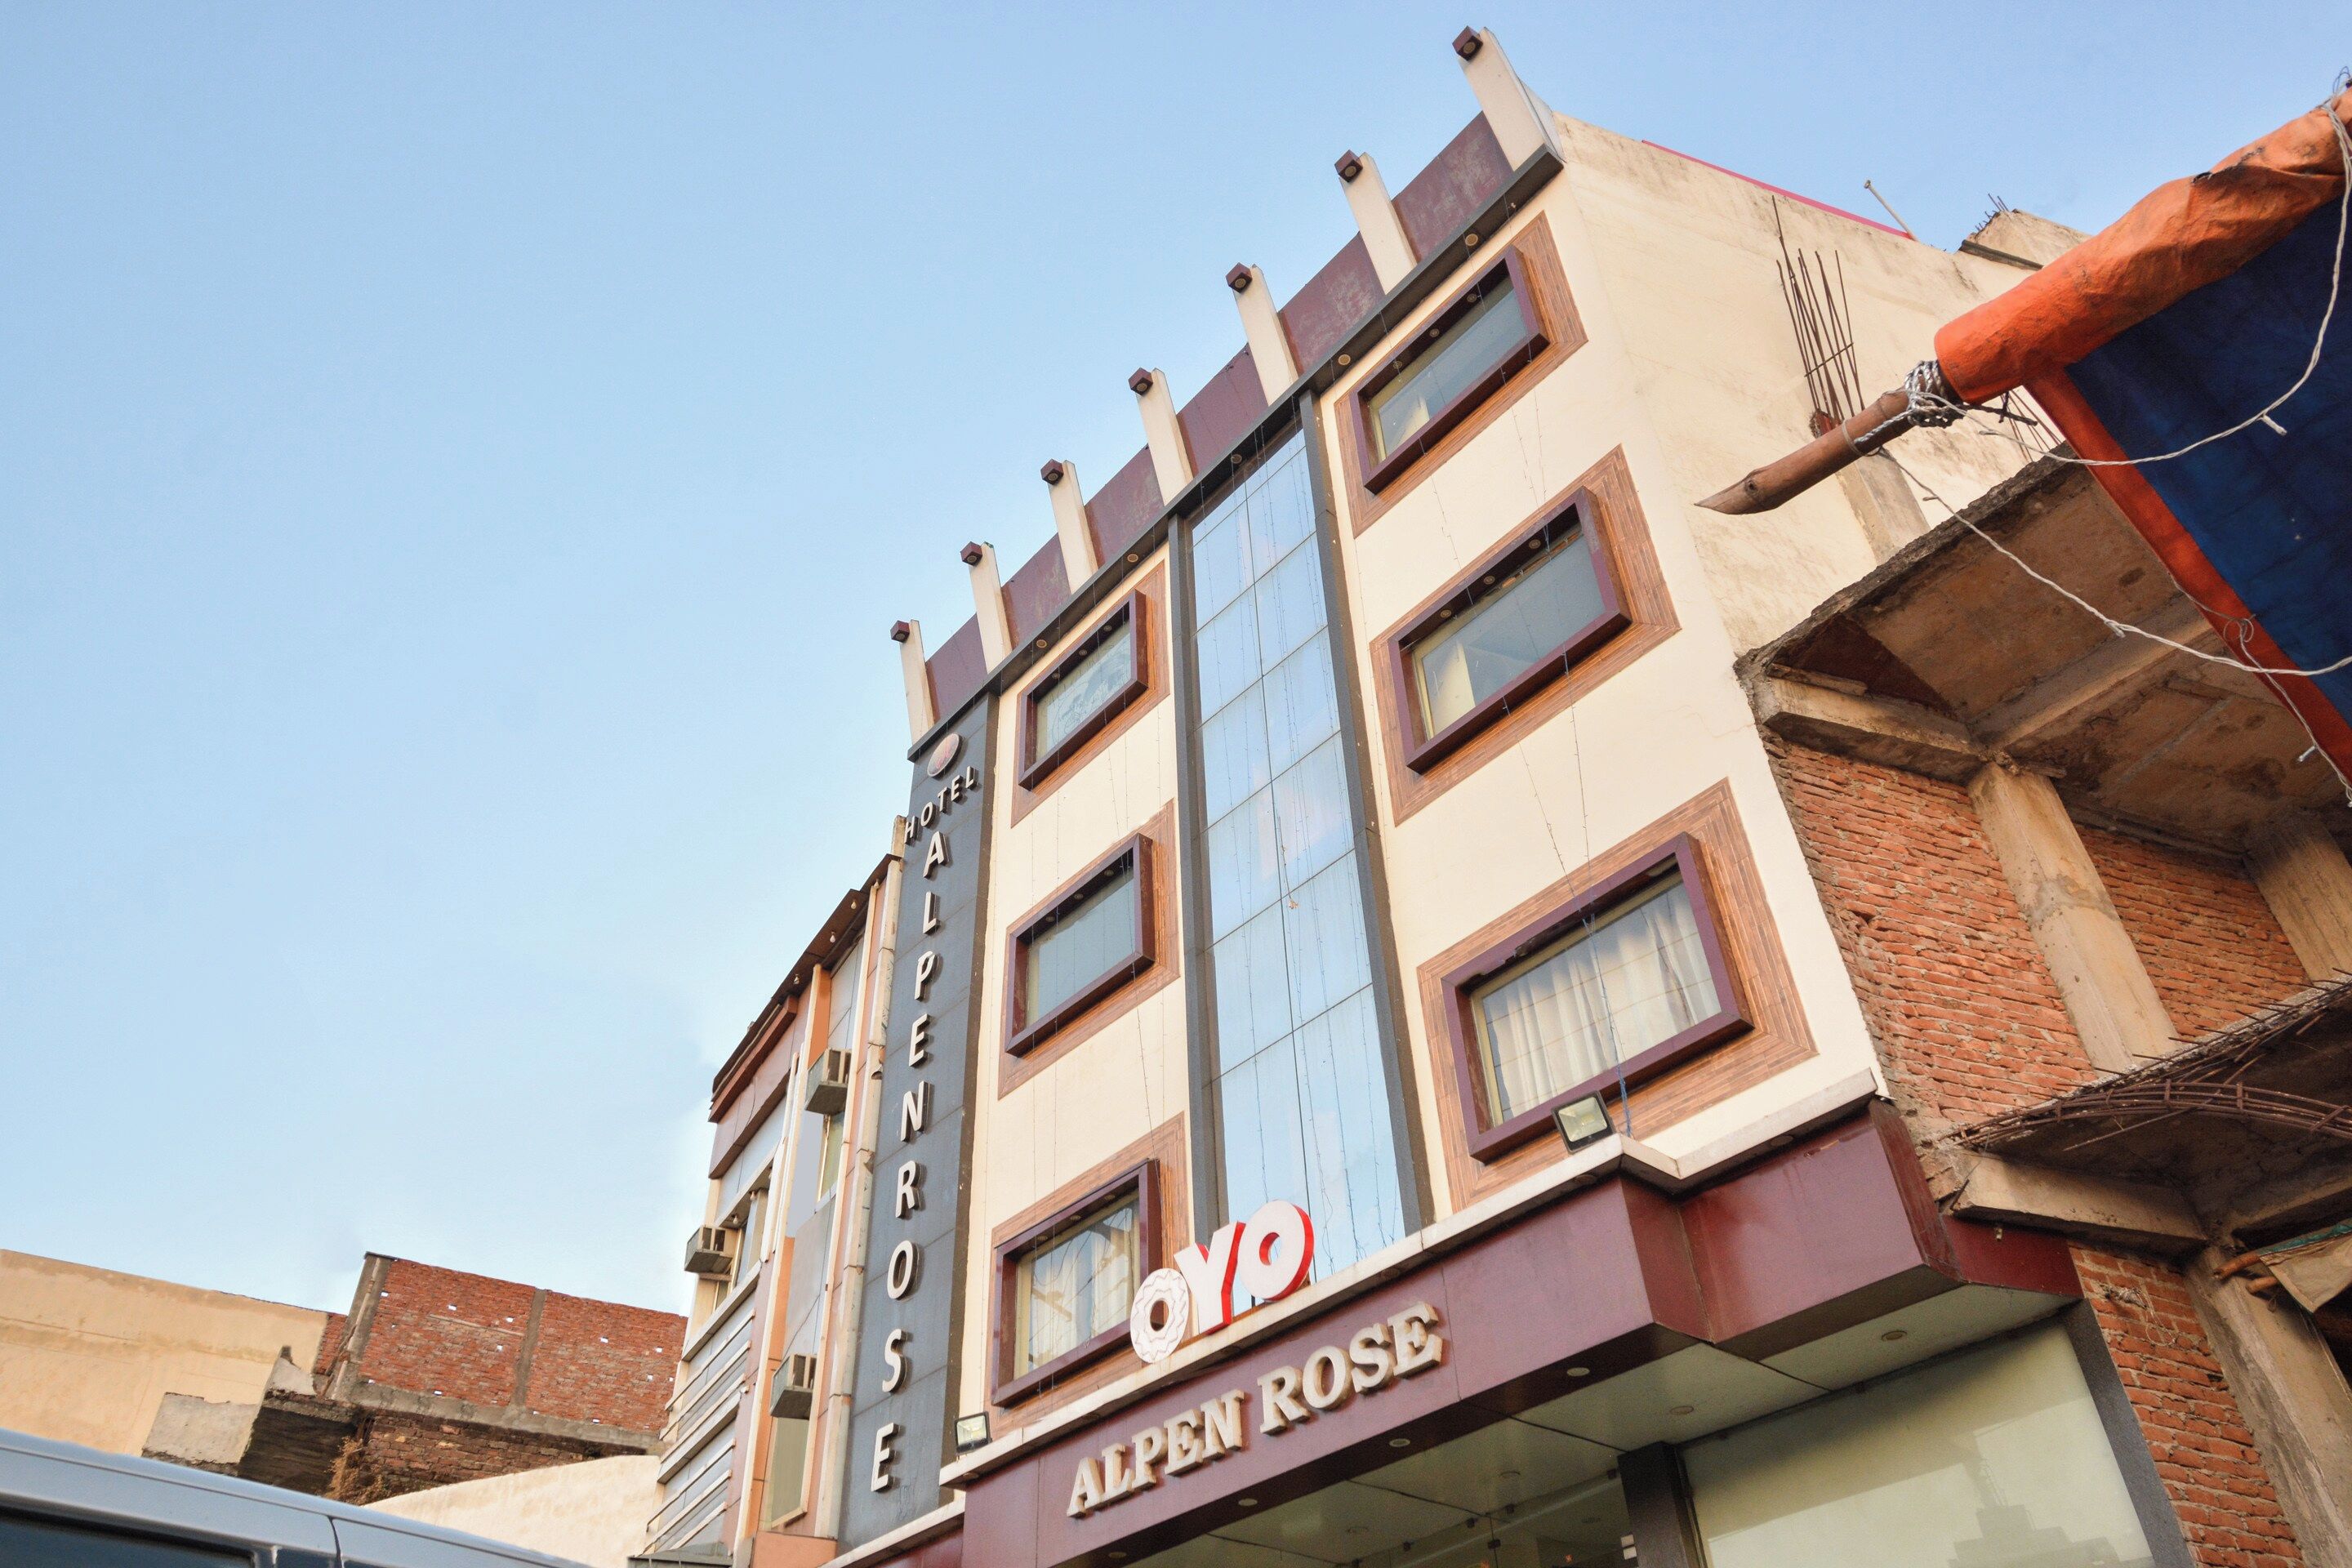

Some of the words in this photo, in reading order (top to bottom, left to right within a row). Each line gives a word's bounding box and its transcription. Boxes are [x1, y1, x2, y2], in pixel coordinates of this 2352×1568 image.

[904, 766, 978, 844] HOTEL
[1130, 1199, 1315, 1363] OYO
[1067, 1389, 1245, 1517] ALPEN
[1258, 1301, 1444, 1435] ROSE
